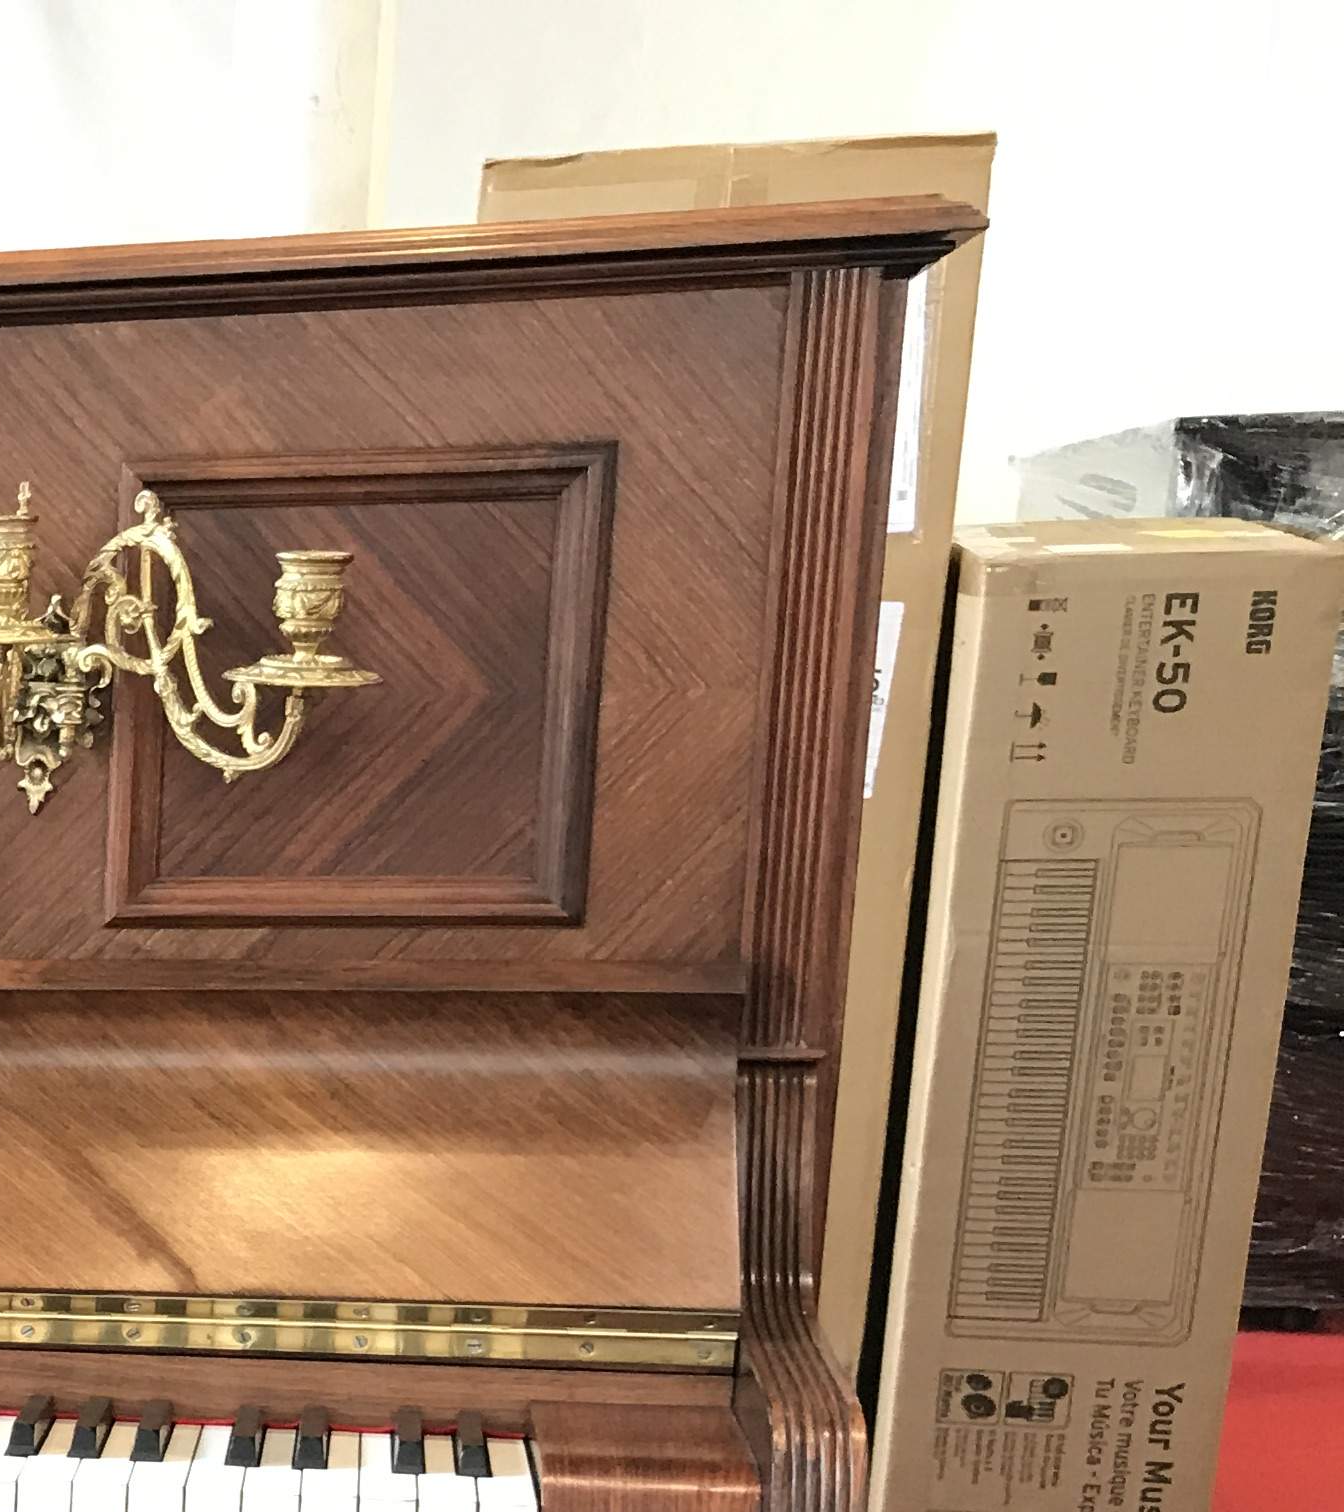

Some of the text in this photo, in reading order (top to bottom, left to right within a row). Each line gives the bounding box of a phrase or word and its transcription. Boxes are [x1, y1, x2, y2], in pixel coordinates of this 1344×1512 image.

[1152, 592, 1200, 713] EK-50
[1246, 590, 1278, 654] KORG
[1122, 593, 1156, 765] ENTERTAINER KEYBOARD
[1095, 1378, 1115, 1399] Tu
[1119, 1379, 1144, 1428] Votre
[1148, 1382, 1186, 1451] Your
[1086, 1404, 1112, 1465] Música
[1108, 1432, 1132, 1507] musique
